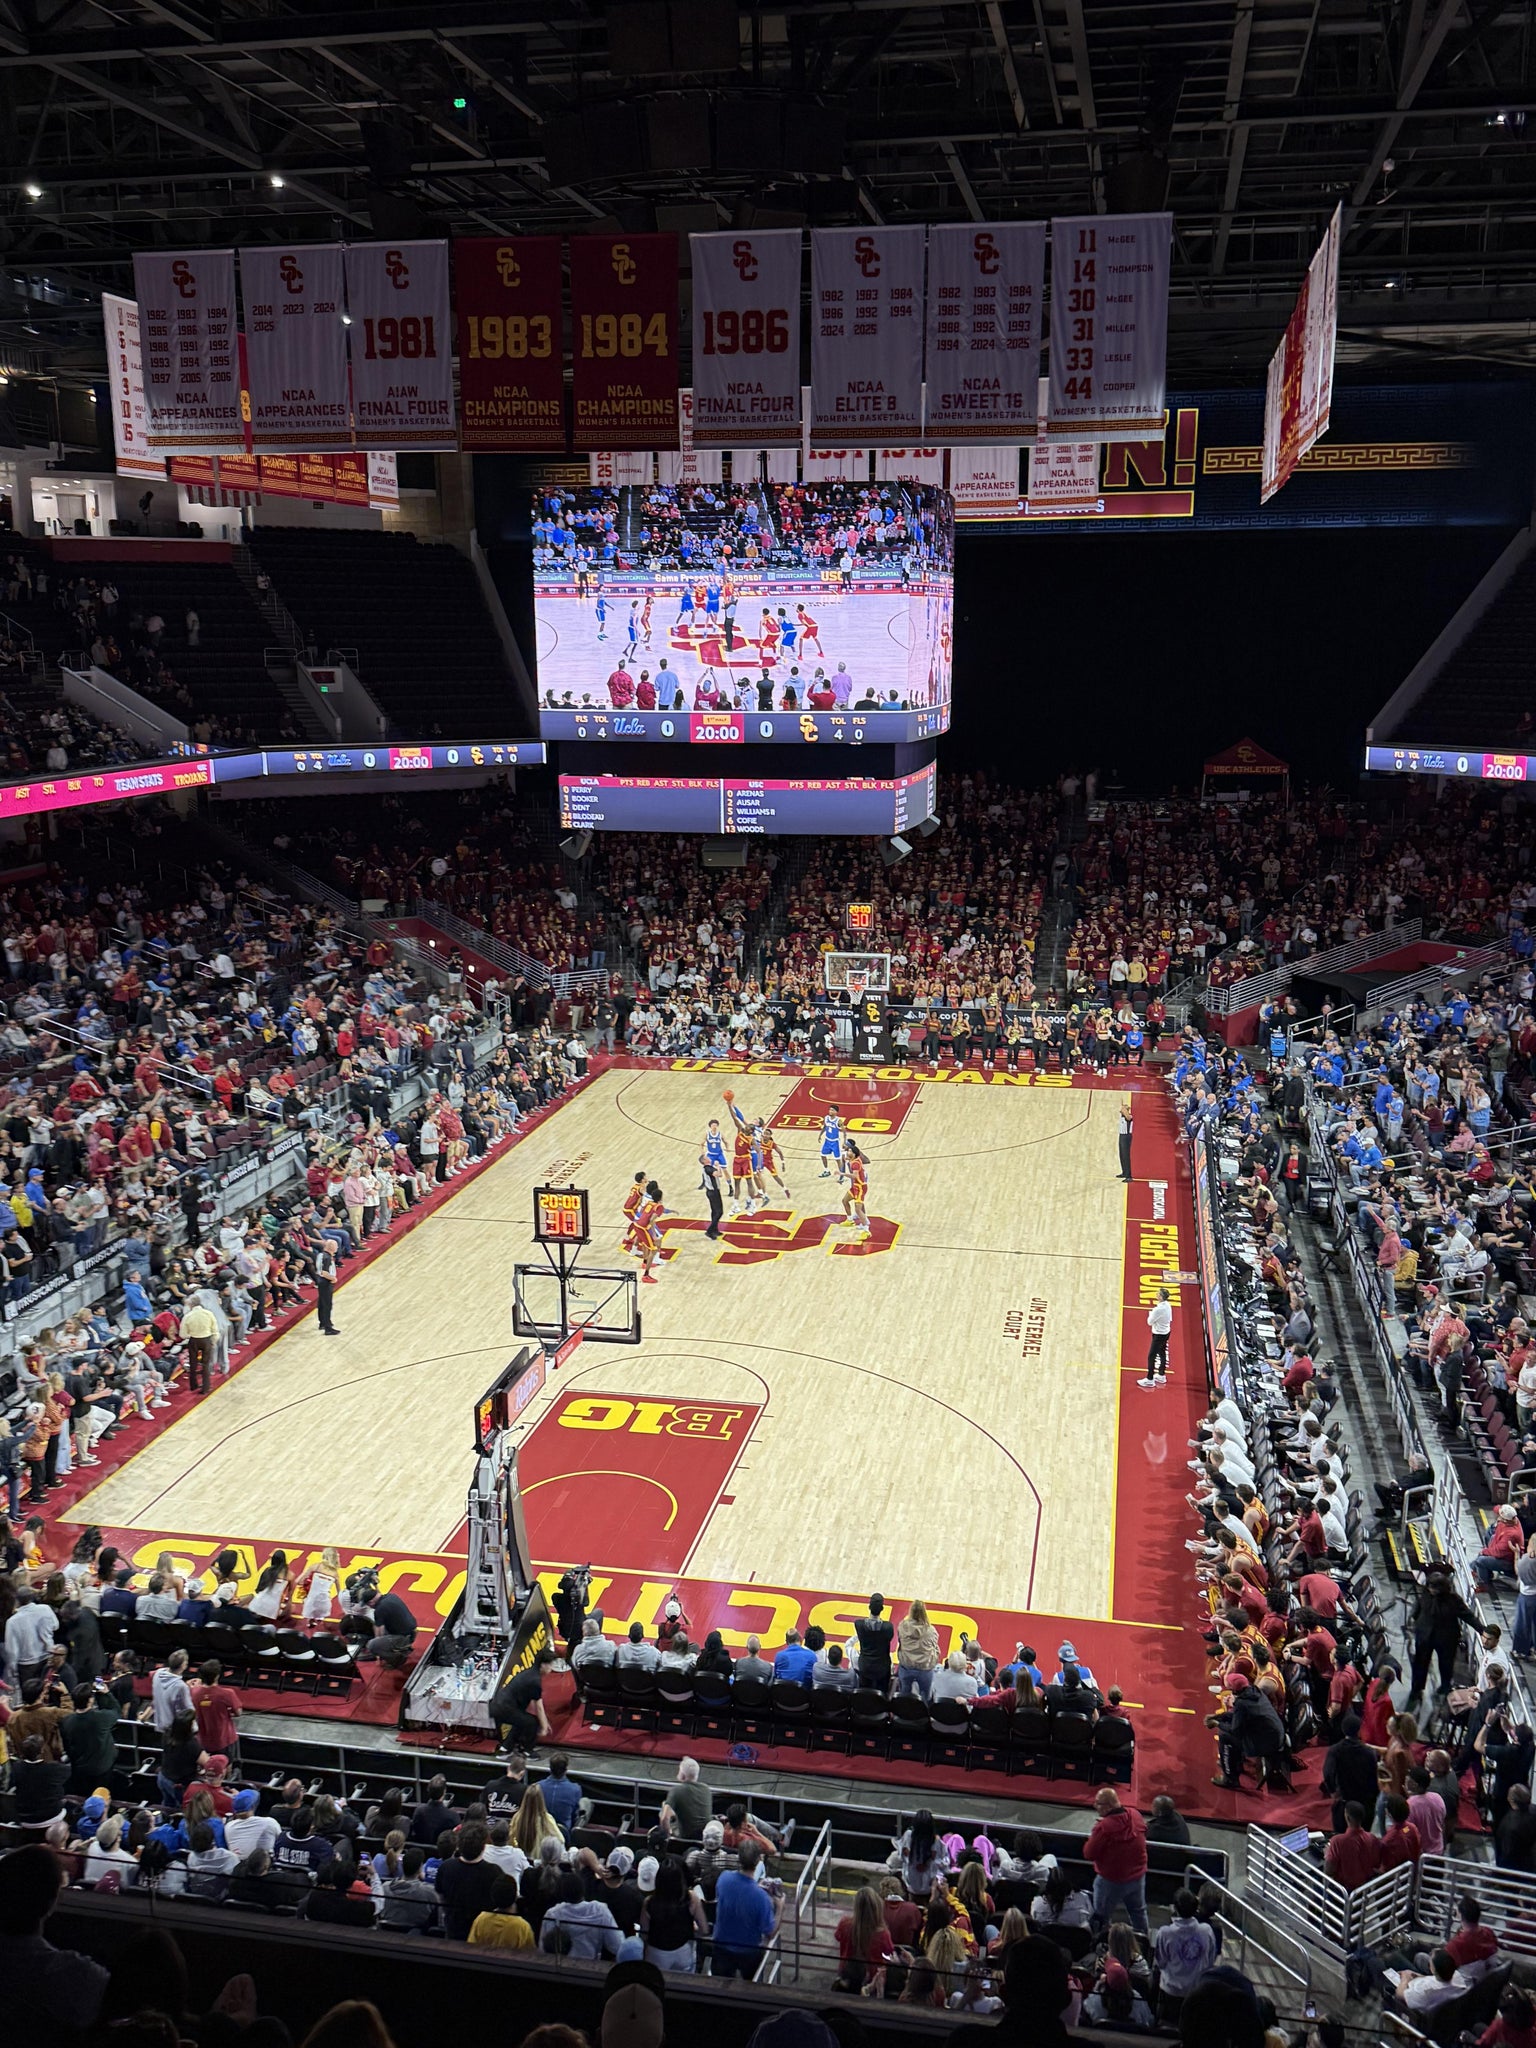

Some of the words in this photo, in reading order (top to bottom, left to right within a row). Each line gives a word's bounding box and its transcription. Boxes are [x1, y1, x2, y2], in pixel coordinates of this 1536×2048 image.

[1079, 230, 1096, 253] 11
[1108, 235, 1136, 244] McGEE
[733, 241, 758, 281] SC
[855, 237, 880, 277] SC
[974, 233, 999, 274] SC
[385, 250, 409, 289] SC
[496, 247, 521, 287] SC
[611, 243, 637, 286] SC
[1074, 259, 1096, 282] 14
[1108, 265, 1154, 273] THOMPSON
[172, 260, 196, 298] SC
[280, 255, 303, 294] SC
[821, 290, 843, 302] 1982
[855, 289, 878, 300] 1983
[890, 288, 913, 299] 1984
[938, 287, 961, 298] 1982
[973, 286, 996, 297] 1983
[1009, 285, 1032, 297] 1984
[1068, 289, 1095, 312] 30
[252, 305, 273, 316] 2014
[283, 304, 304, 315] 2023
[313, 303, 335, 313] 2024
[821, 308, 843, 319] 1986
[855, 307, 877, 318] 1992
[890, 306, 912, 317] 1994
[938, 305, 960, 316] 1985
[973, 304, 996, 315] 1986
[1008, 303, 1031, 314] 1987
[254, 321, 274, 332] 2025
[703, 309, 788, 355] 1986
[820, 325, 844, 336] 2024
[854, 324, 877, 335] 2025
[937, 322, 960, 333] 1988
[972, 321, 995, 333] 1992
[1008, 320, 1030, 332] 1993
[1073, 318, 1094, 341] 31
[1105, 324, 1136, 333] MILLER
[364, 317, 436, 360] 1981
[466, 314, 552, 359] 1983
[580, 312, 668, 358] 1984
[937, 340, 959, 351] 1994
[970, 339, 995, 350] 2024
[1006, 338, 1030, 349] 2025
[1066, 348, 1093, 371] 33
[1104, 354, 1132, 362] LESLIE
[493, 386, 529, 398] NCAA
[607, 384, 643, 397] NCAA
[727, 383, 763, 395] NCAA
[847, 381, 884, 393] NCAA
[963, 379, 1000, 390] NCAA
[1064, 377, 1092, 400] 44
[1103, 383, 1136, 391] COOPER
[176, 393, 208, 404] NCAA
[282, 389, 316, 401] NCAA
[942, 393, 1000, 409] SWEET
[1005, 393, 1023, 408] 16
[256, 404, 345, 418] APPEARANCES
[359, 401, 401, 416] FINAL
[408, 400, 448, 415] FOUR
[465, 400, 560, 416] CHAMPIONS
[577, 399, 674, 416] CHAMPIONS
[698, 397, 746, 413] FINAL
[750, 397, 793, 412] FOUR
[836, 397, 882, 412] ELITE
[1053, 407, 1097, 416] WOMEN'S
[151, 407, 237, 419] APPEARANCES
[816, 414, 856, 422] WOMEN'S
[859, 413, 916, 422] BASKETBALL
[975, 411, 1032, 419] BASKETBALL
[466, 417, 504, 426] WOMEN'S
[507, 417, 560, 426] BASKETBALL
[578, 417, 617, 425] WOMEN'S
[620, 417, 674, 425] BASKETBALL
[597, 464, 612, 478] 25
[972, 472, 996, 480] NCAA
[1051, 469, 1075, 477] NCAA
[954, 481, 1015, 491] APPEARANCES
[1033, 478, 1095, 488] APPEARANCES
[593, 715, 608, 723] TOL
[830, 717, 846, 725] TOL
[852, 717, 866, 725] FLS
[578, 727, 587, 738] 0
[598, 727, 607, 738] 4
[661, 720, 675, 737] 0
[695, 726, 739, 741] 20:00
[759, 721, 773, 738] 0
[834, 729, 843, 740] 4
[855, 729, 863, 740] 0
[363, 753, 376, 768] 0
[393, 756, 429, 769] 20:00
[447, 749, 459, 764] 0
[1213, 765, 1231, 773] USC
[1232, 765, 1280, 773] ATHLETICS
[1457, 756, 1468, 774] 0
[1485, 764, 1523, 779] 20:00
[114, 777, 139, 792] TEAM
[139, 774, 164, 788] STATS
[173, 772, 208, 786] TROJANS
[689, 780, 702, 788] BLK
[706, 780, 719, 788] FLS
[736, 790, 764, 798] ARENAS
[736, 799, 760, 807] AUSAR
[725, 825, 735, 833] 13
[736, 825, 764, 833] WOODS
[849, 905, 872, 914] 20:00
[851, 913, 869, 928] 30
[866, 1002, 880, 1023] SC
[670, 1059, 788, 1075] USC
[801, 1064, 1073, 1087] TROJANS
[539, 1194, 581, 1209] 20:00
[546, 1209, 578, 1236] 30
[1140, 1223, 1180, 1272] FIGHT
[1029, 1297, 1048, 1313] JIM
[1002, 1310, 1024, 1340] COURT
[1022, 1315, 1046, 1358] STERKEL
